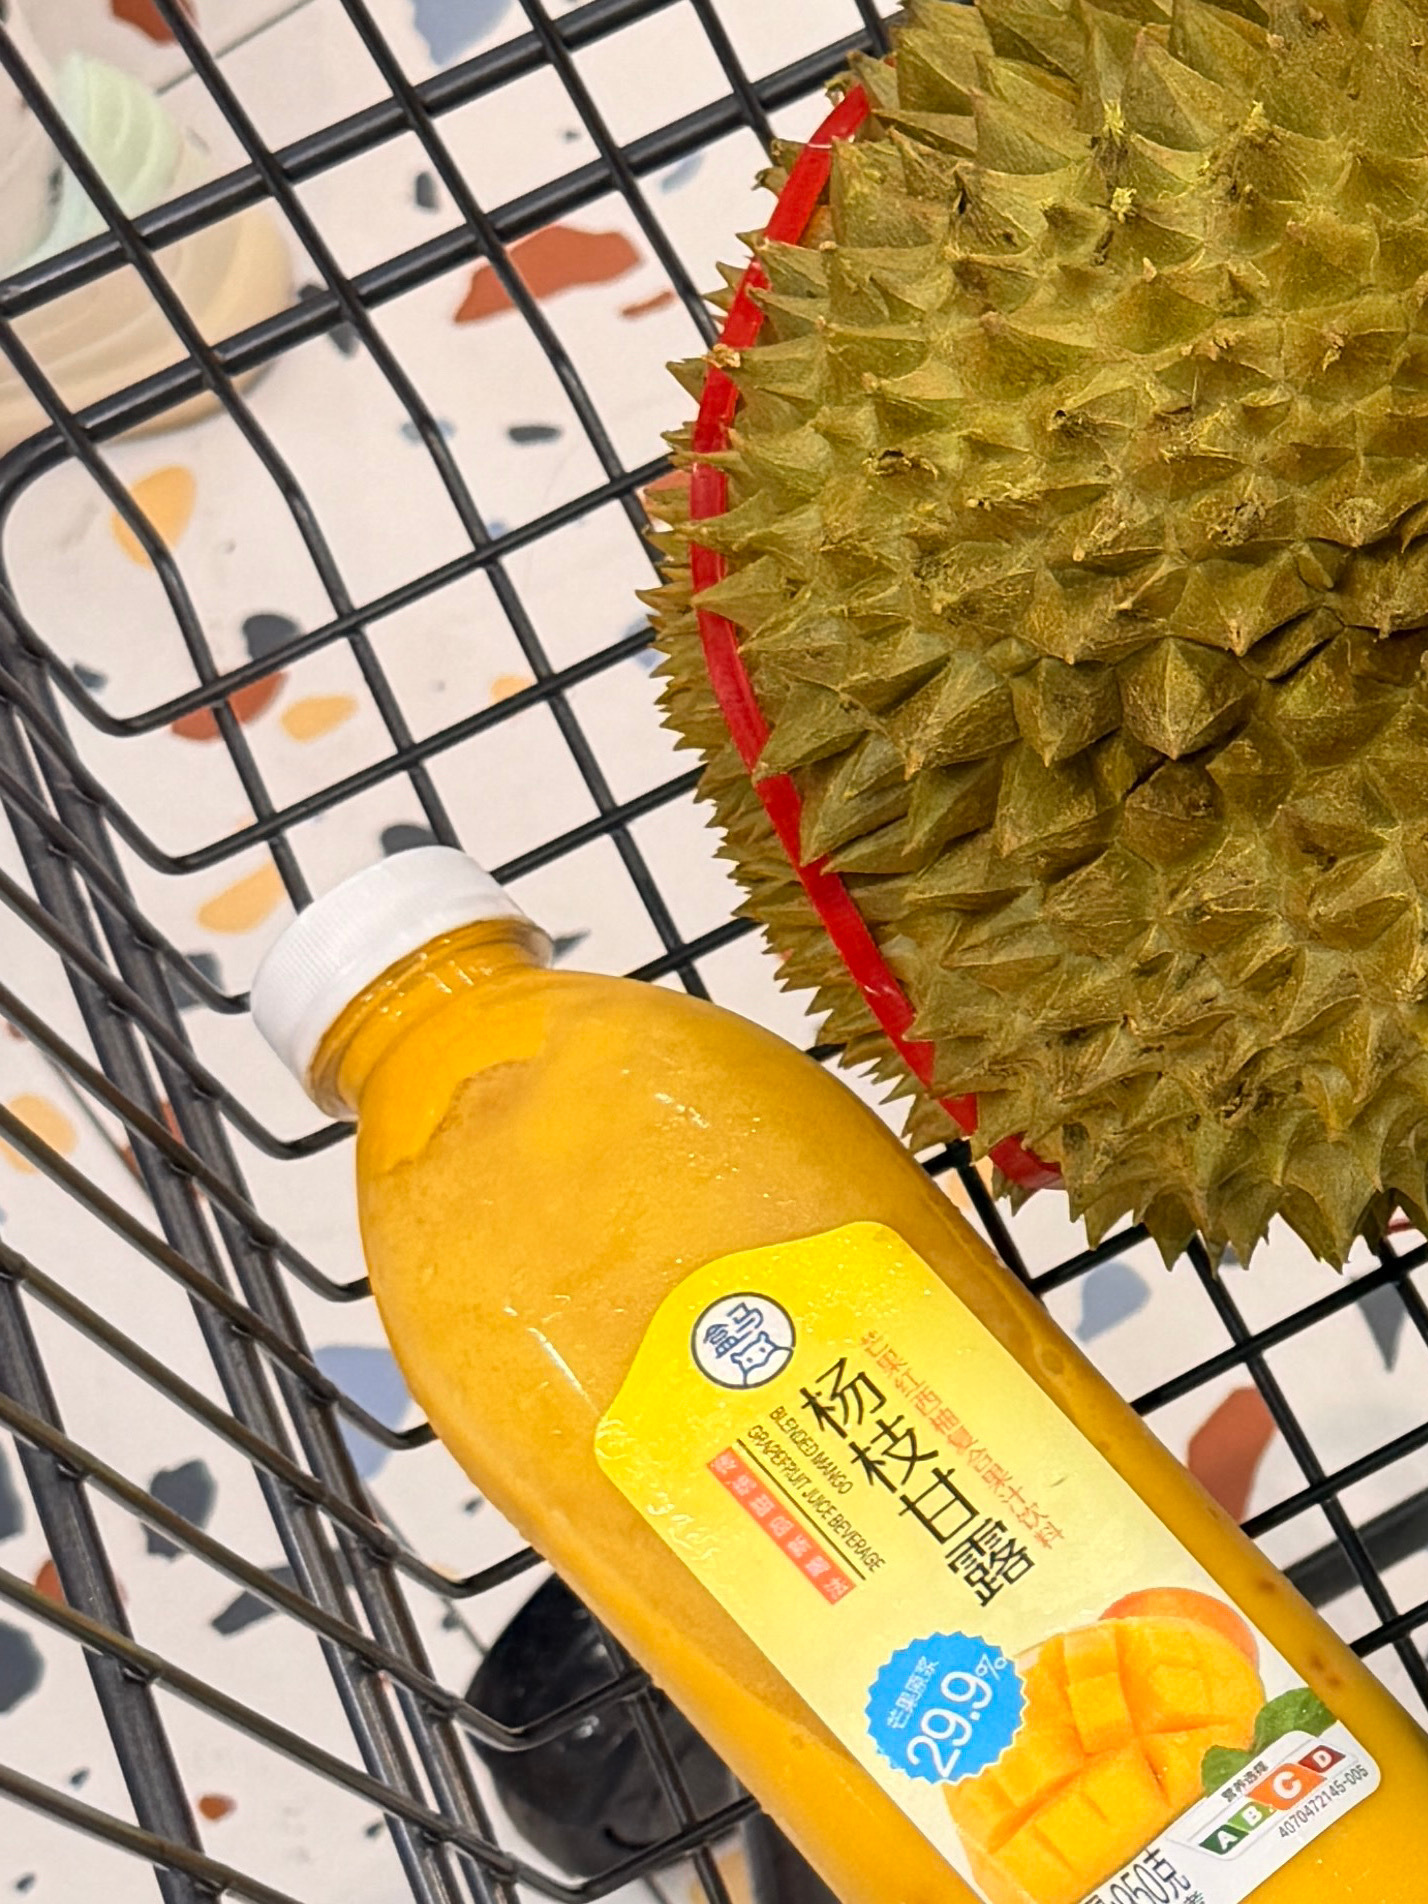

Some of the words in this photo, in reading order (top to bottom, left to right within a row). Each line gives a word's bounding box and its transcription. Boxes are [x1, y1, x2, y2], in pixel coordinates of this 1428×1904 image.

[746, 1423, 812, 1491] GRAPEFRUIT
[801, 1483, 837, 1520] JUICE
[828, 1514, 885, 1573] BEVERAGE
[769, 1405, 820, 1458] BLENDED
[812, 1451, 855, 1495] MANGO
[800, 1357, 1036, 1608] 杨枝甘露
[907, 1653, 1005, 1778] 29.9%
